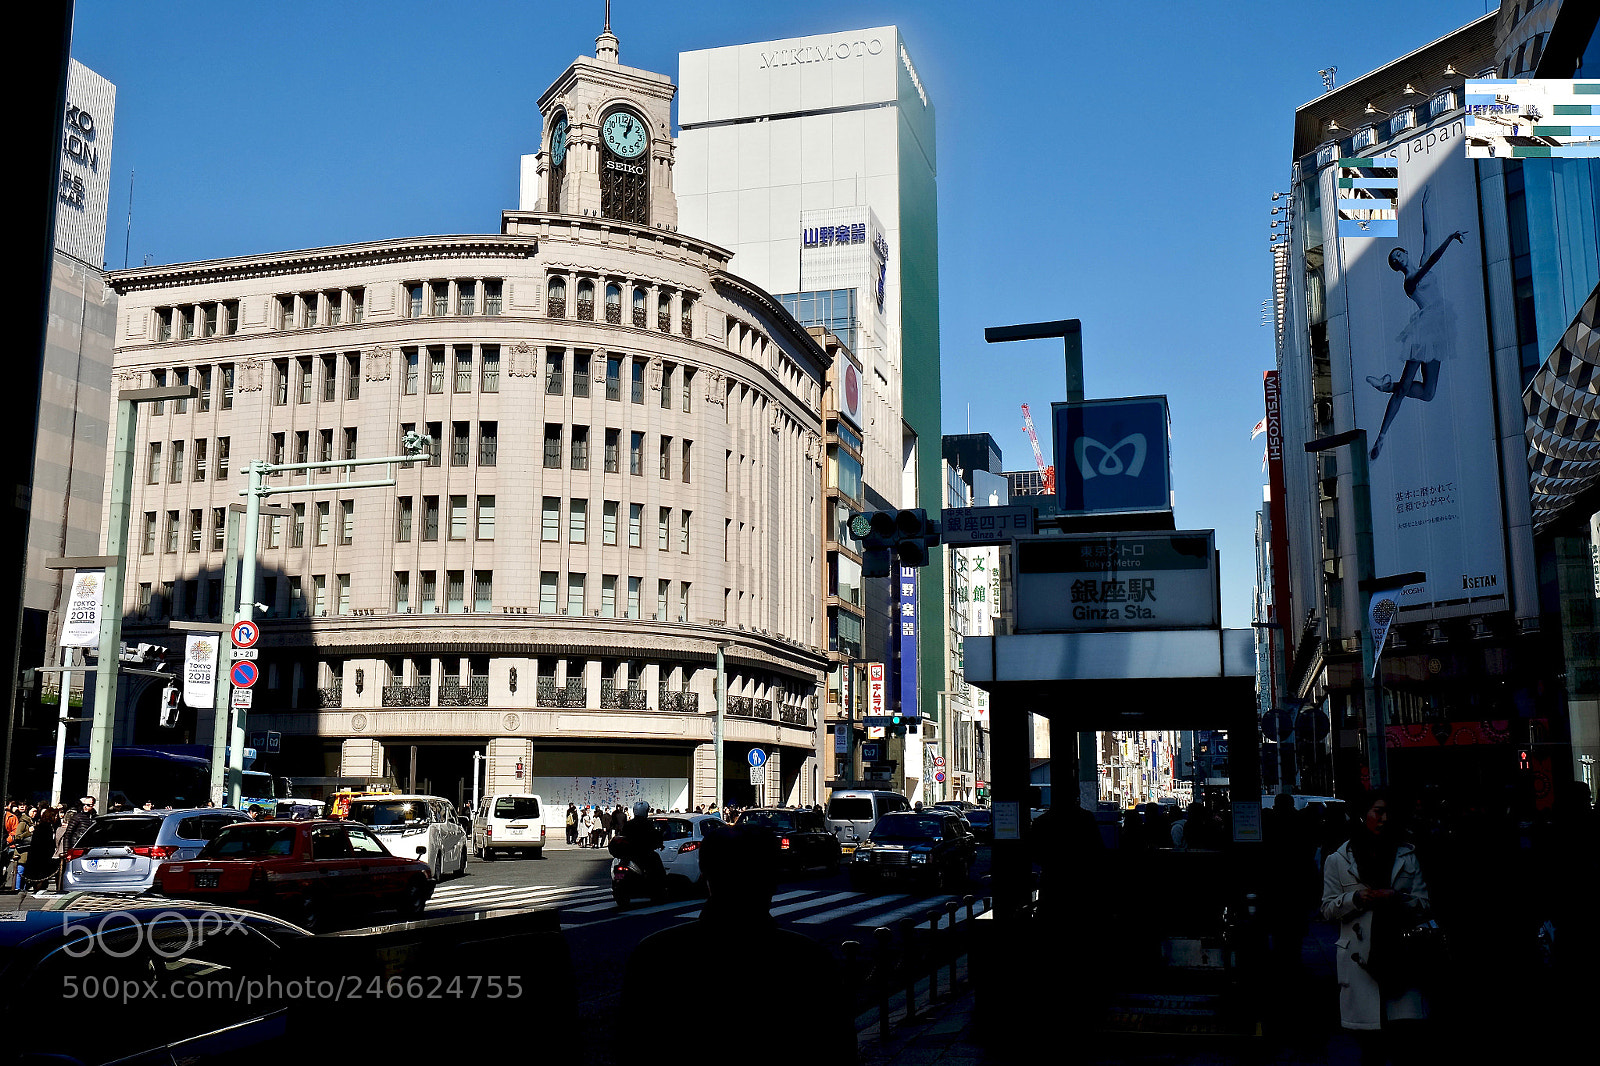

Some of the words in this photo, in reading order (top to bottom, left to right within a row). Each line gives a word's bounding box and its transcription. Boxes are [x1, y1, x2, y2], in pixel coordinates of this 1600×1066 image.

[760, 39, 882, 69] MIKIMOTO
[606, 160, 644, 175] SEIKO
[803, 223, 866, 245] 山野楽器
[1266, 376, 1281, 460] MITSUKOSHI
[947, 514, 1028, 532] 銀座四丁目
[971, 531, 994, 540] Ginza
[997, 530, 1003, 538] 4
[1080, 544, 1145, 559] 東京メトロ
[1084, 559, 1111, 569] Tokyo
[1114, 558, 1141, 568] Metro
[1462, 574, 1498, 590] ISETAN
[1070, 578, 1157, 604] 銀座駅
[901, 566, 915, 636] 山野楽器
[71, 611, 96, 620] 2018
[1072, 605, 1120, 621] Ginza
[1124, 604, 1156, 620] Sta.
[189, 662, 212, 670] TOKYO
[189, 672, 211, 681] 2018
